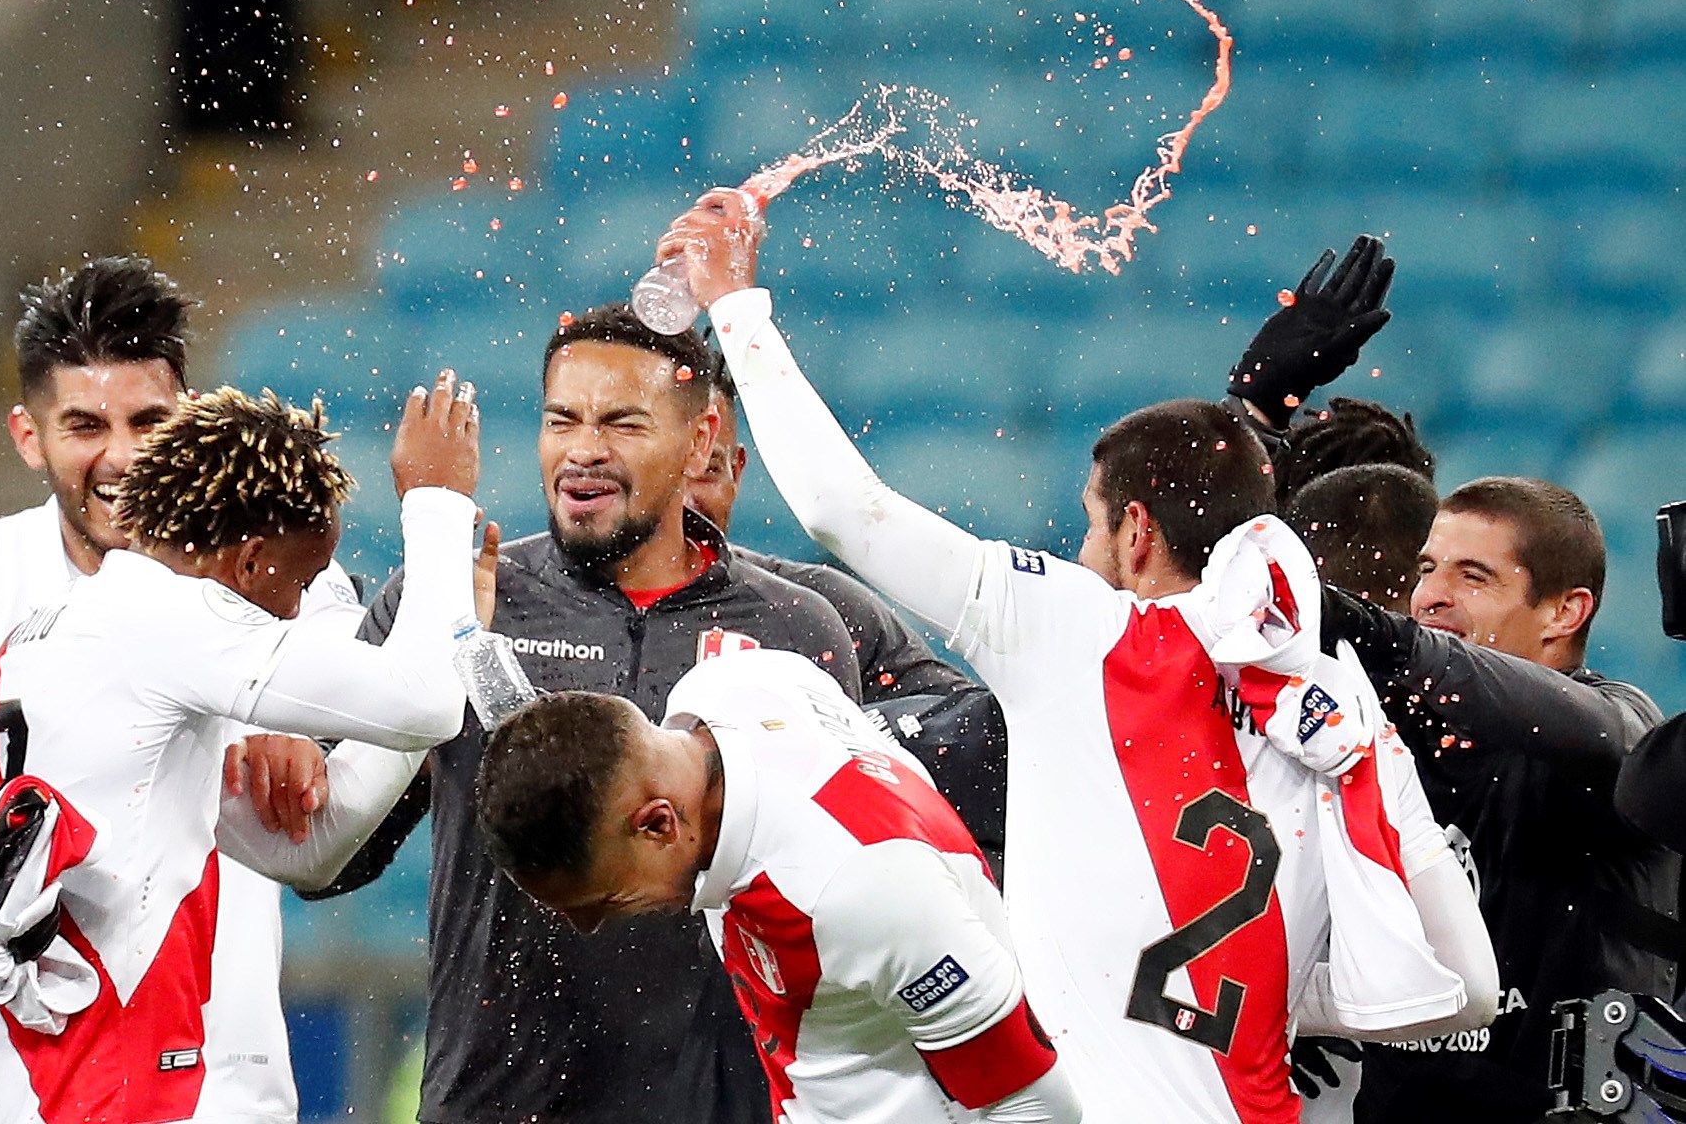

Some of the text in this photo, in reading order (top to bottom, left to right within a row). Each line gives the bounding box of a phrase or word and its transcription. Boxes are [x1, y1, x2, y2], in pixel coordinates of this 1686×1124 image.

[1124, 787, 1283, 1057] 2
[902, 961, 955, 999] Cree en
[911, 972, 960, 1010] grande
[1441, 1027, 1490, 1052] 2019
